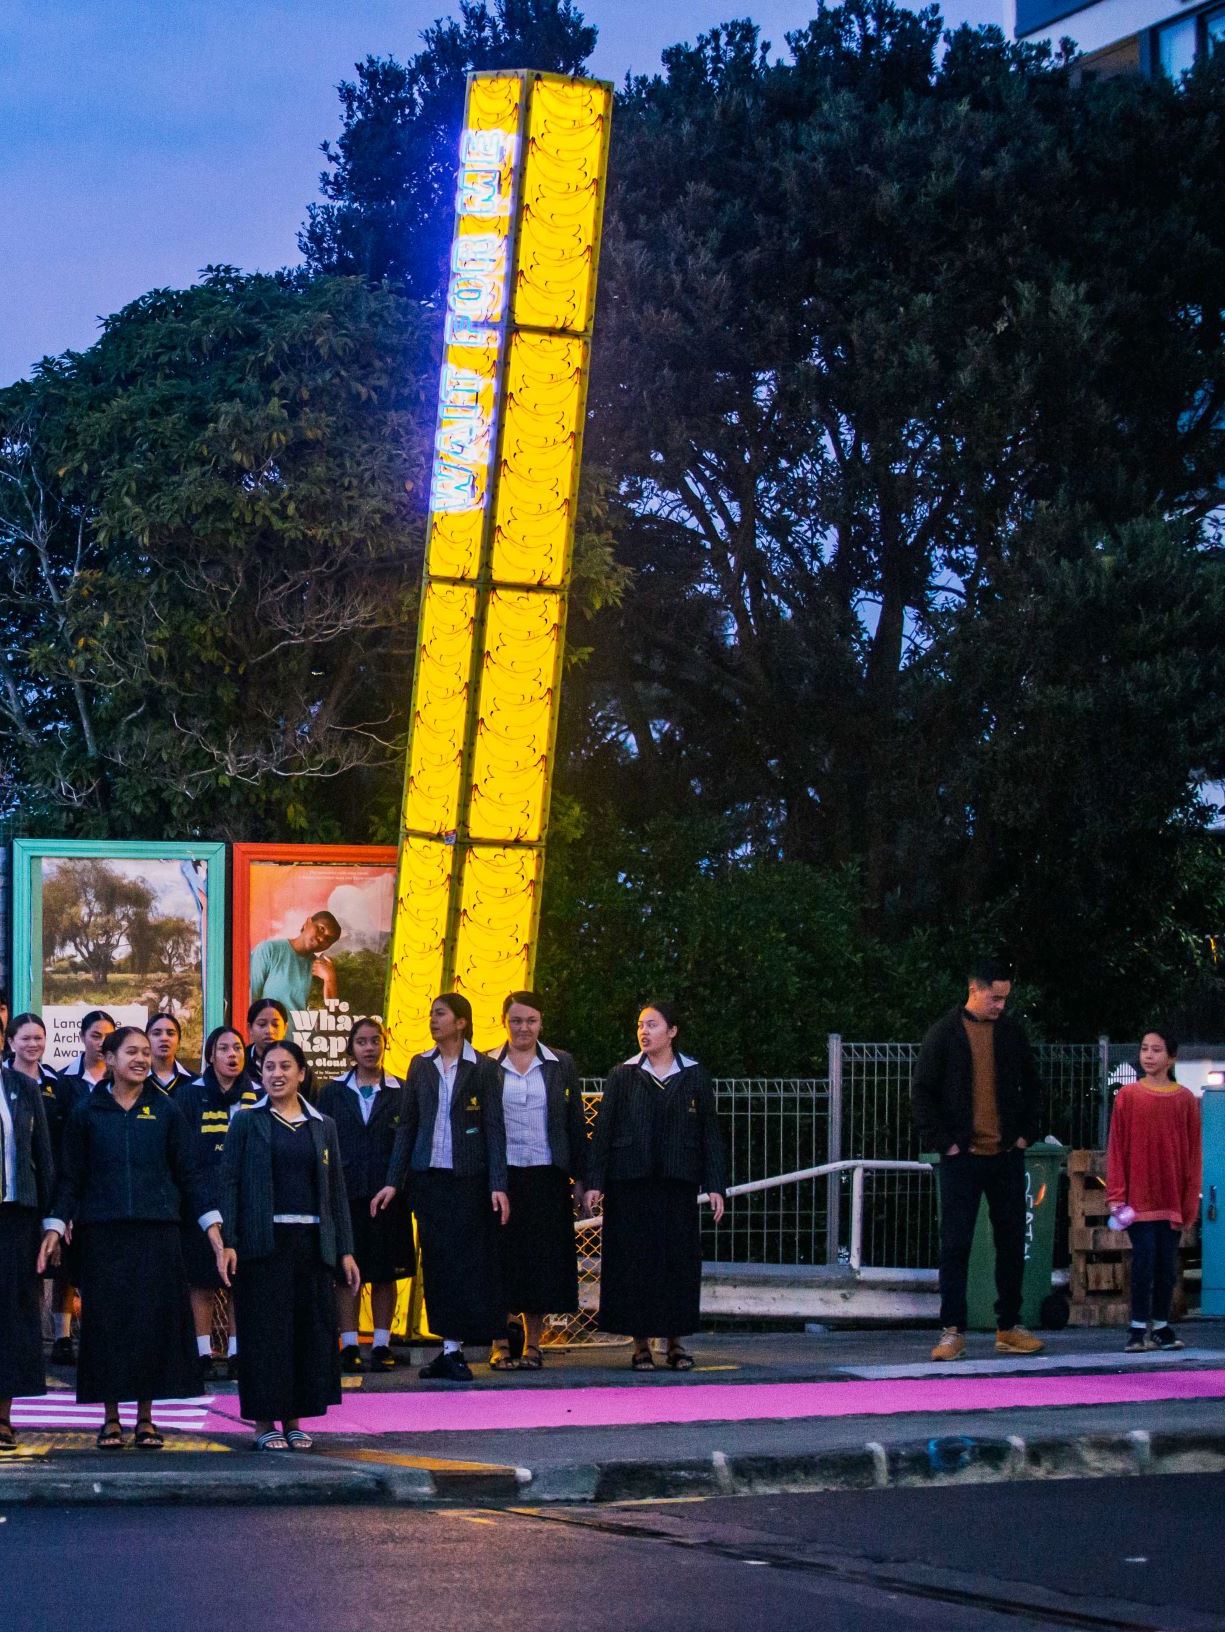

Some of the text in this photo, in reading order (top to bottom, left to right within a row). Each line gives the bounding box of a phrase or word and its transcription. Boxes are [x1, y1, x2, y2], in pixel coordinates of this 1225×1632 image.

[431, 129, 507, 513] WAIT FOR ME
[53, 1033, 82, 1043] Arch
[292, 1032, 350, 1058] Kap
